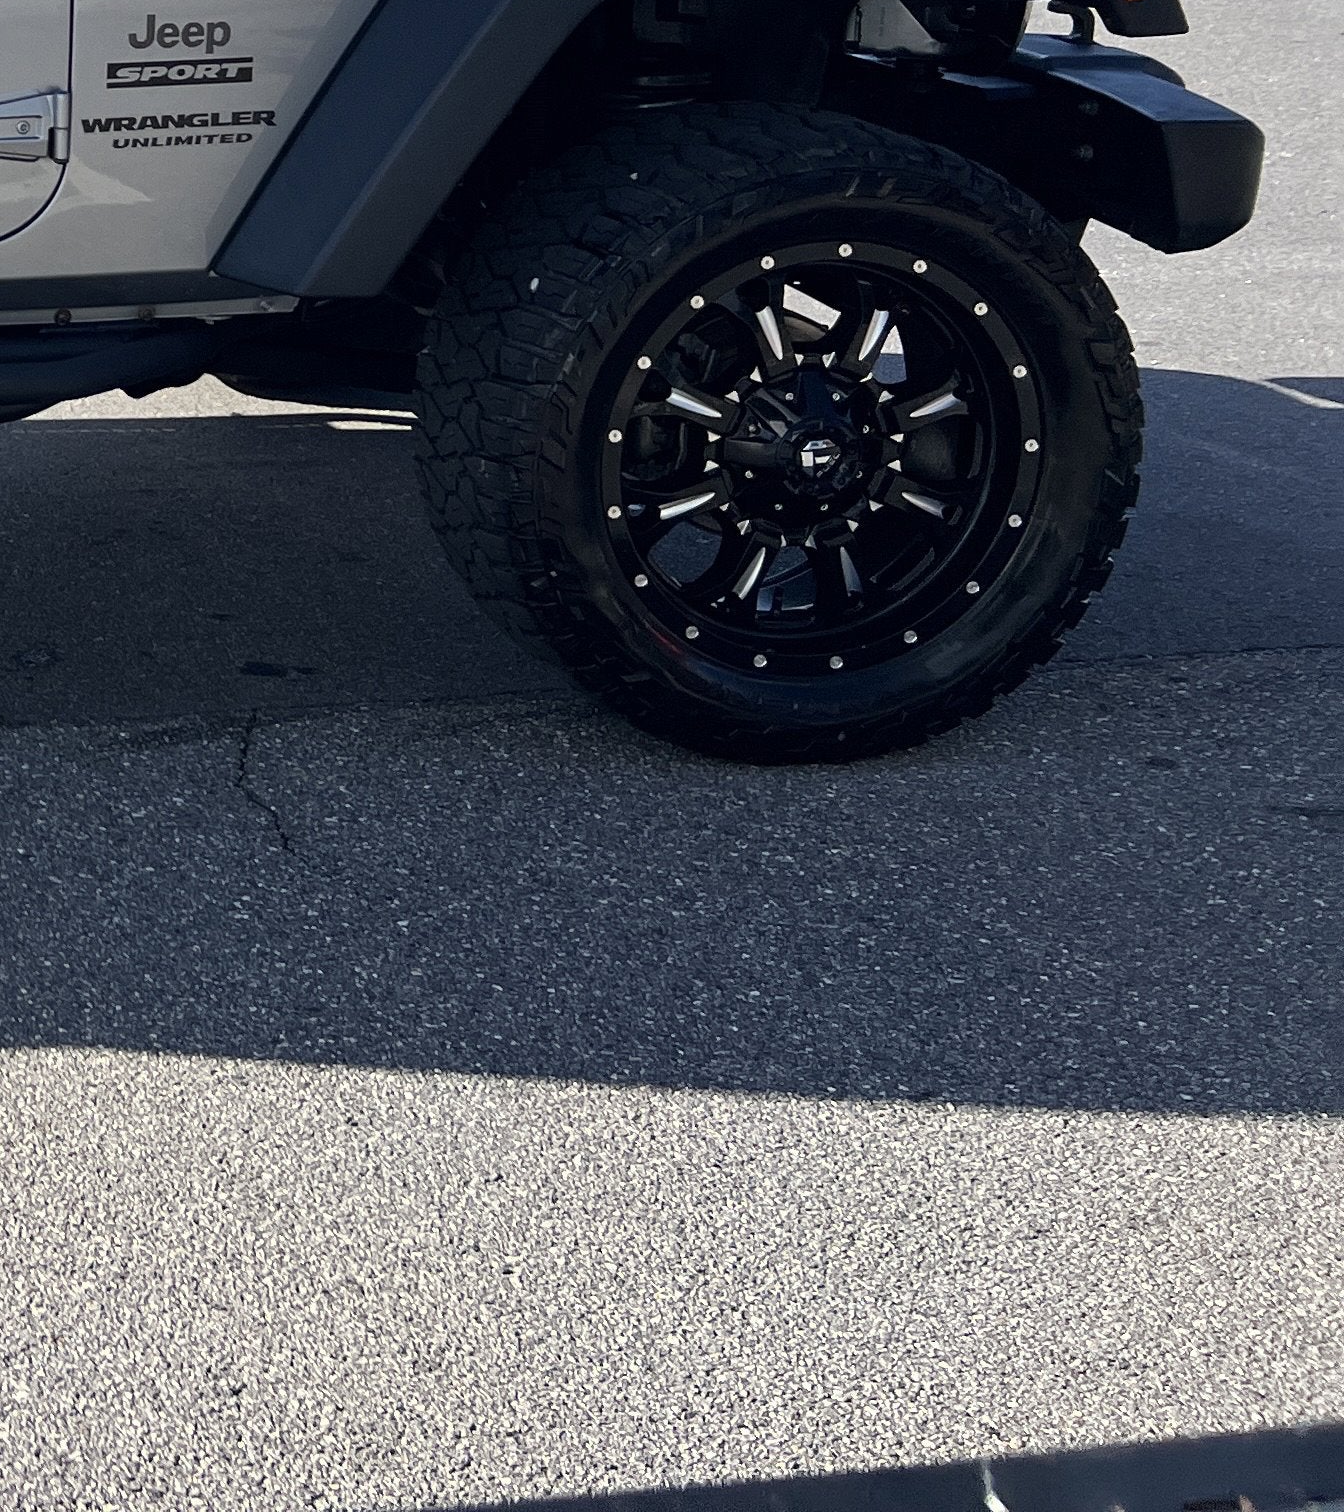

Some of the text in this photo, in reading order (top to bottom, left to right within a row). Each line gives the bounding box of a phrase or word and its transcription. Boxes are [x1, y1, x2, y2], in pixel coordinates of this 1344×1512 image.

[128, 14, 231, 54] Jeep
[108, 62, 253, 85] SPORT
[81, 110, 277, 133] WRANGLER
[113, 133, 253, 149] UNLIMITED
